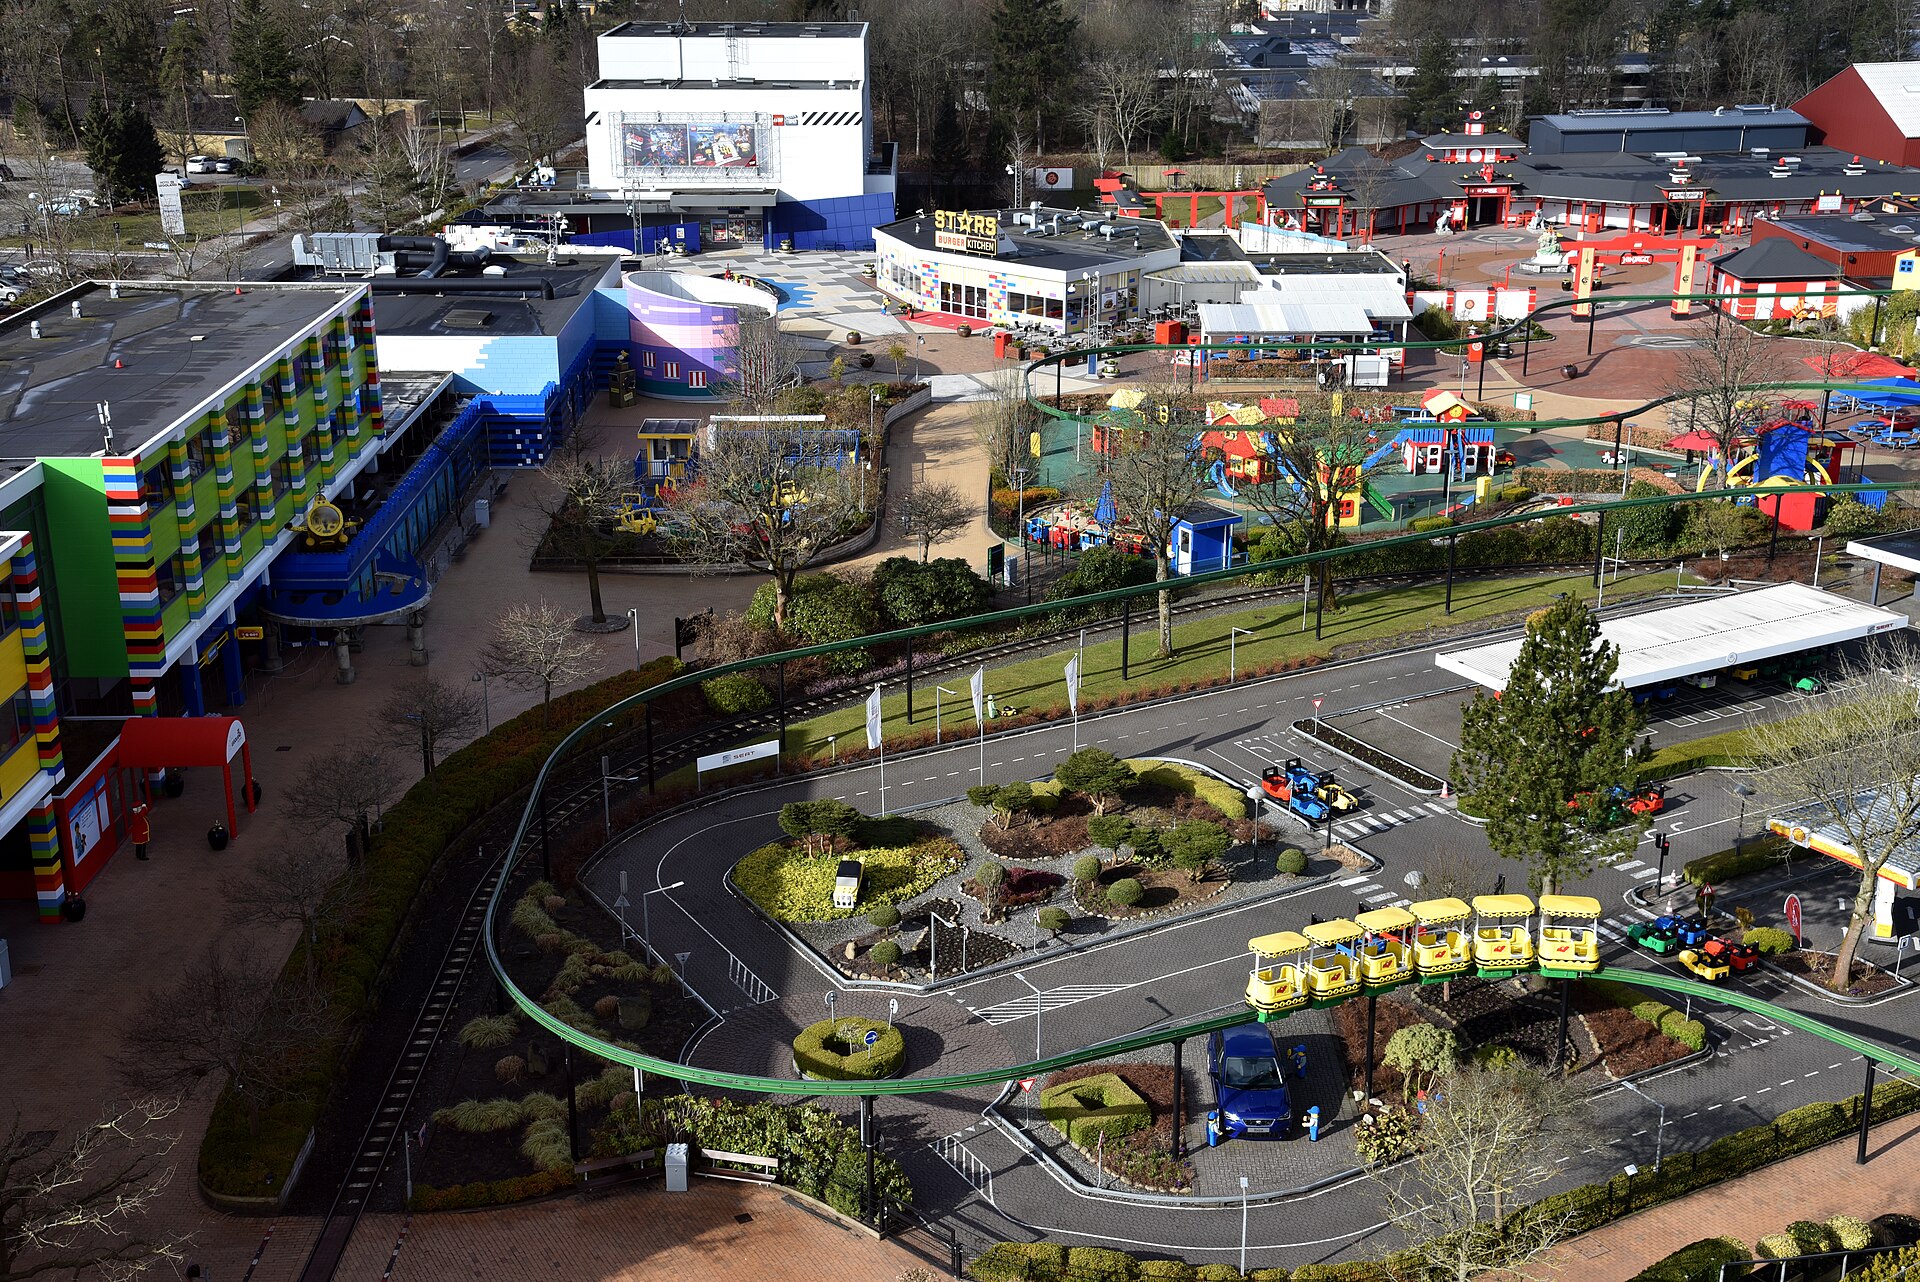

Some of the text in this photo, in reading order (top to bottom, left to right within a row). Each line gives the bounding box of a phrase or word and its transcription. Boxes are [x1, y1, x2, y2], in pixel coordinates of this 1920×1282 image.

[934, 209, 997, 236] STARS
[938, 235, 994, 252] BURGER KITCHEN
[733, 750, 756, 760] SEAT
